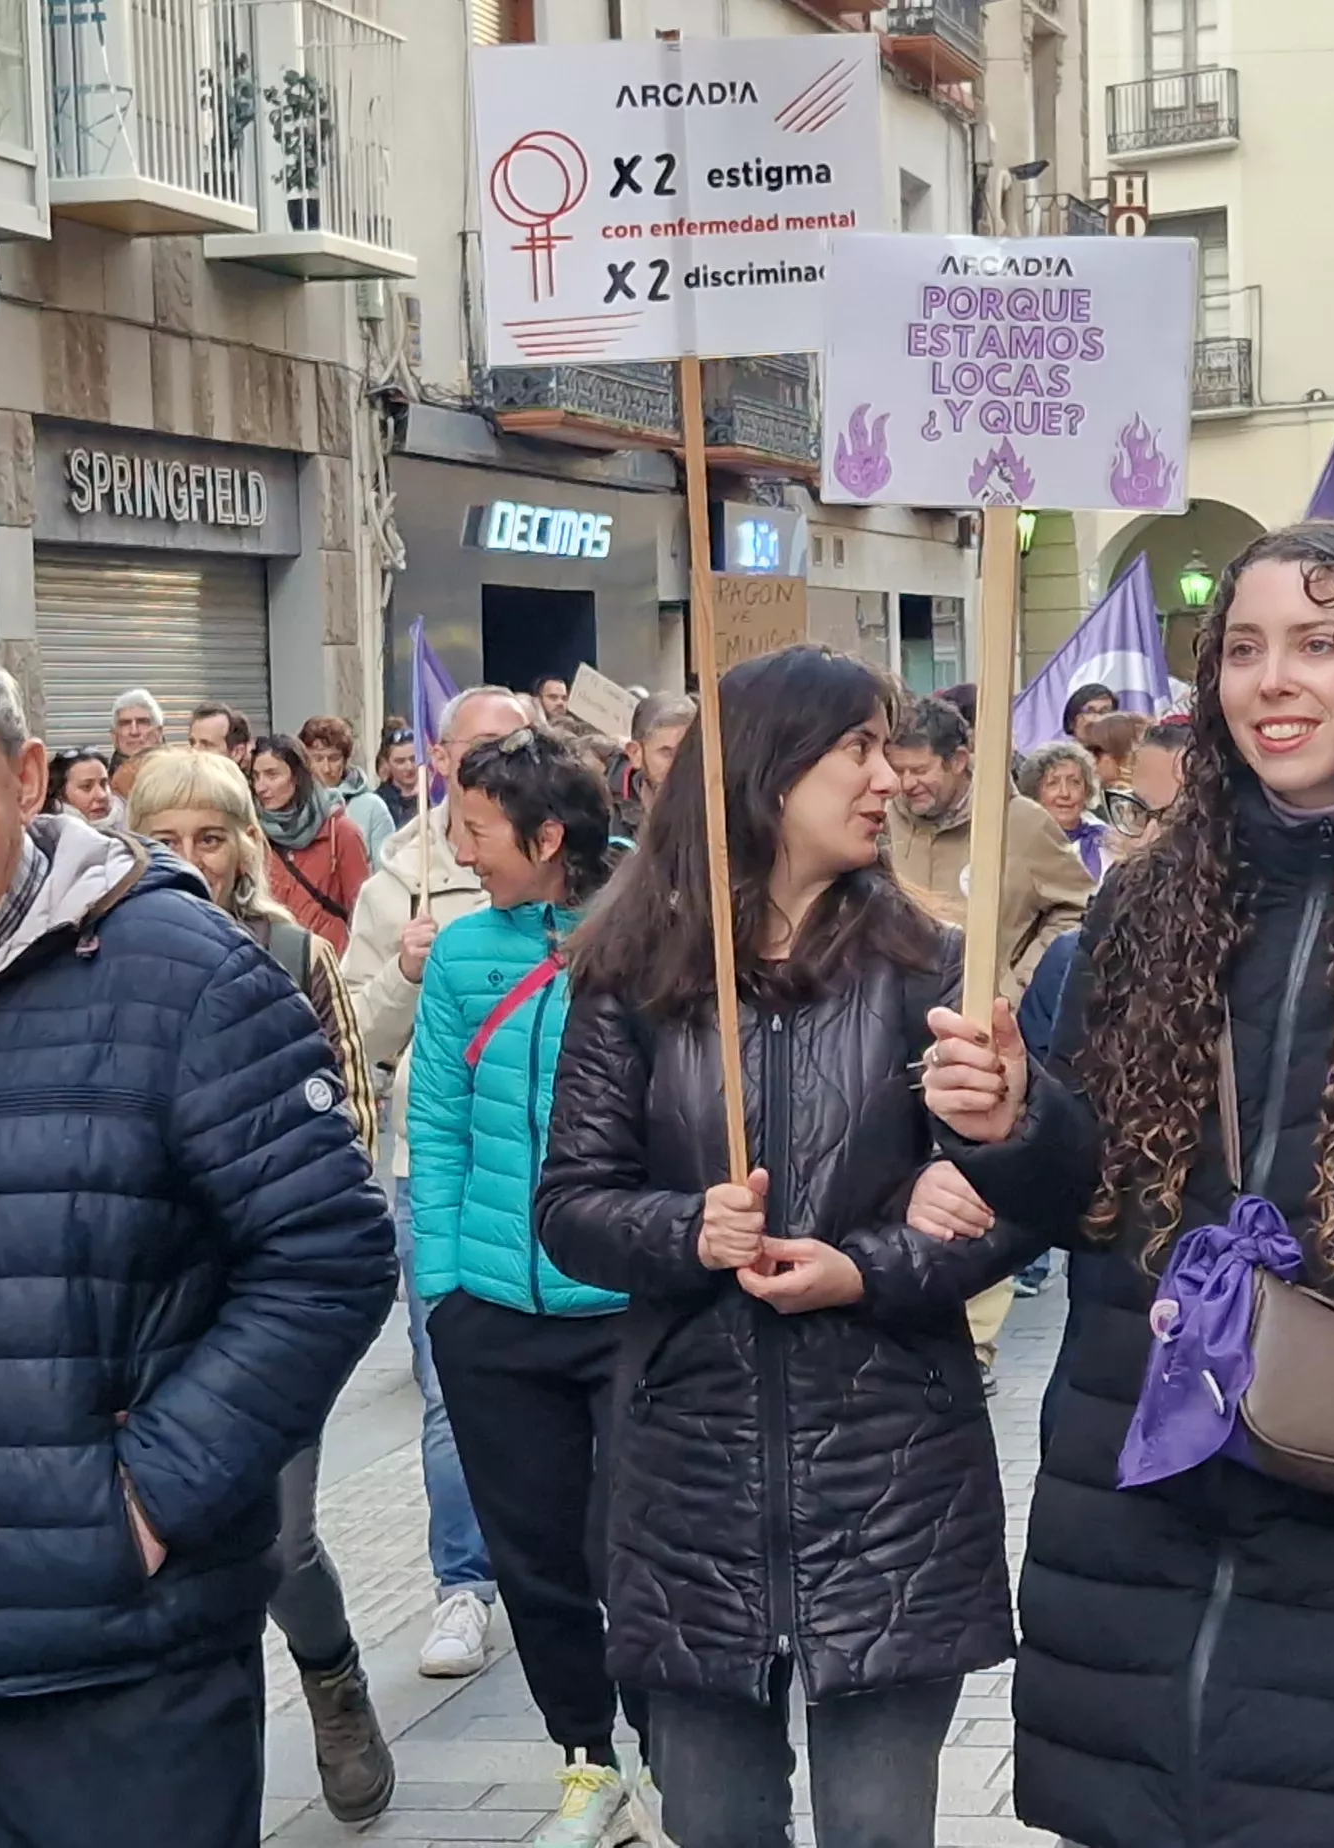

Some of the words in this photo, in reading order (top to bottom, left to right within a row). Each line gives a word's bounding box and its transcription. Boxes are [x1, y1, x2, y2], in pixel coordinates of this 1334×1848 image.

[706, 157, 832, 192] estigma
[601, 222, 643, 239] con
[650, 212, 779, 237] enfermedad
[785, 209, 855, 231] mental
[922, 285, 1092, 323] PORQUE
[906, 322, 1105, 362] ESTAMOS
[931, 361, 1072, 398] LOCAS
[978, 399, 1086, 437] QUE?
[67, 447, 268, 527] SPRINGFIELD
[486, 500, 614, 559] DECIMAS
